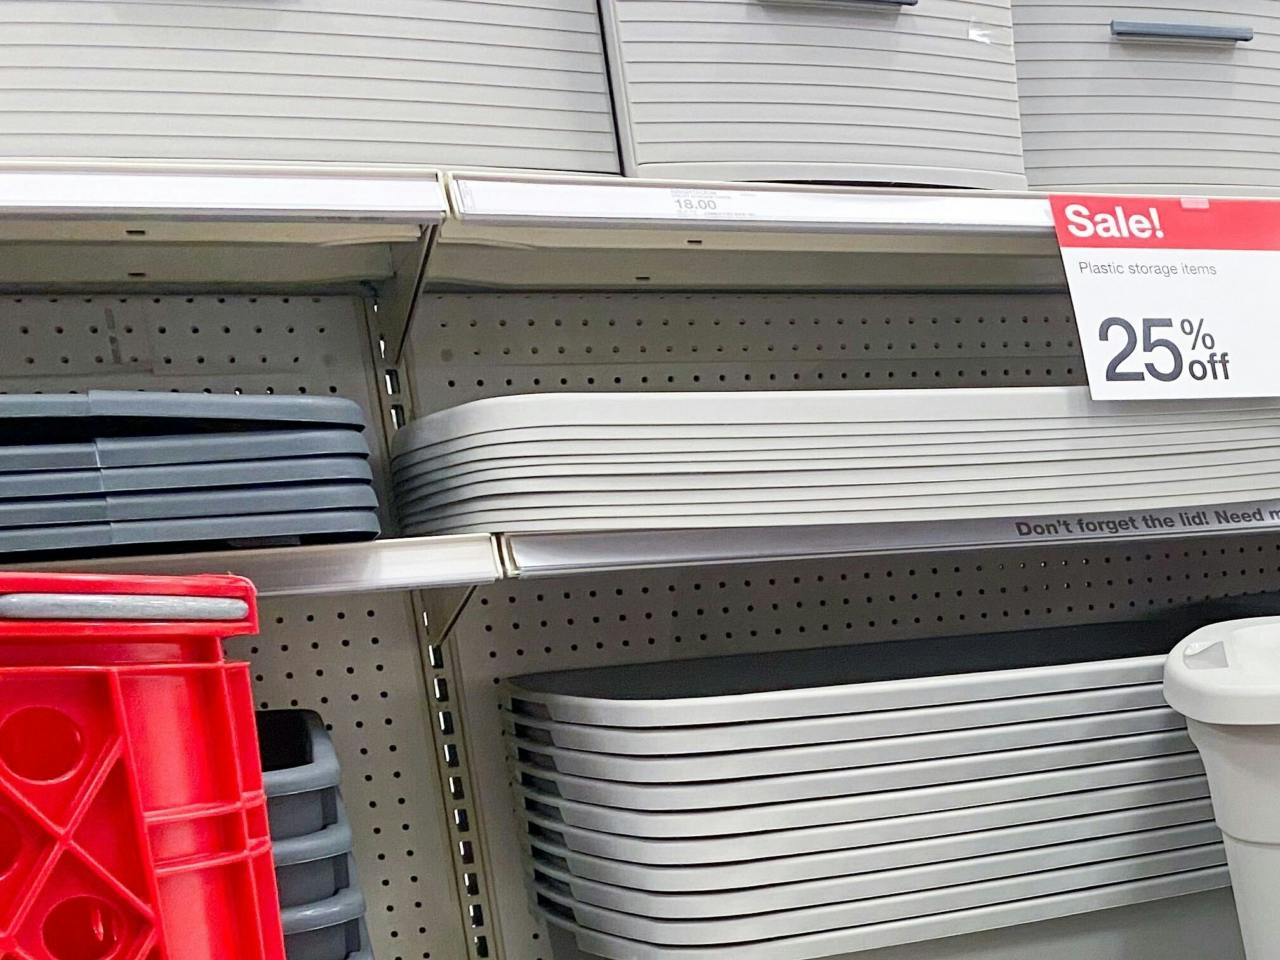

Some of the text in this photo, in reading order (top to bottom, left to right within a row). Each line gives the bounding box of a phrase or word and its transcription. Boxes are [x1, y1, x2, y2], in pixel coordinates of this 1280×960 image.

[675, 199, 717, 210] 18.00
[1064, 204, 1164, 239] Sale!
[1079, 261, 1217, 278] Plastic storage items
[1188, 352, 1231, 381] off
[1015, 518, 1073, 537] Don't
[1077, 515, 1138, 534] forget
[1142, 513, 1175, 530] the
[1178, 510, 1210, 527] lid!
[1214, 507, 1265, 525] Need
